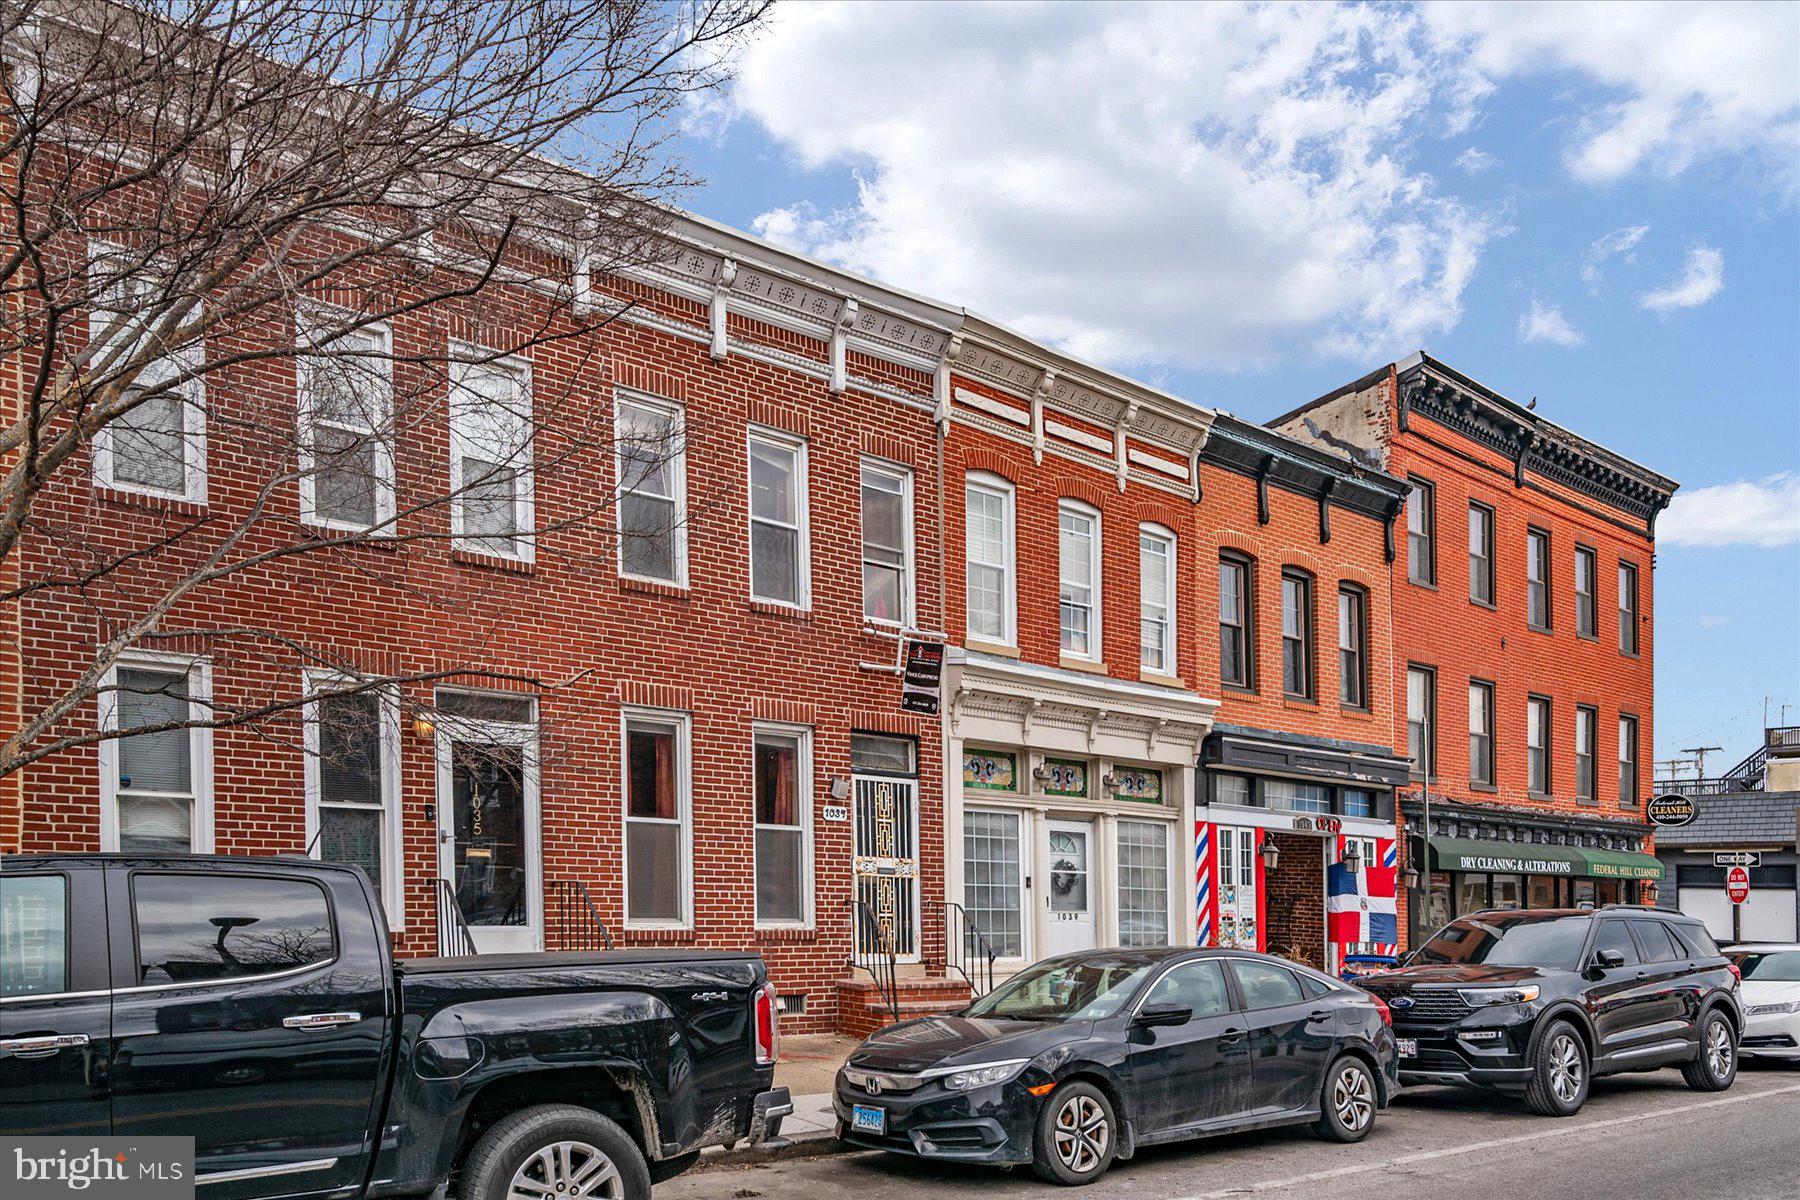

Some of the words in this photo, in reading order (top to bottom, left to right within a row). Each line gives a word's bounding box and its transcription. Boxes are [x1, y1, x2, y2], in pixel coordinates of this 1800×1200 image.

[472, 782, 482, 836] 1035
[1650, 805, 1693, 815] CLEANERS
[1460, 856, 1477, 869] DRY
[1477, 857, 1517, 871] CLEANING
[1517, 859, 1524, 871] &
[1524, 860, 1571, 873] ALTERATIONS
[1593, 864, 1618, 875] FEDERAL
[1619, 865, 1633, 876] HILL
[1634, 866, 1660, 877] CLEANERS
[1057, 912, 1079, 921] 1039
